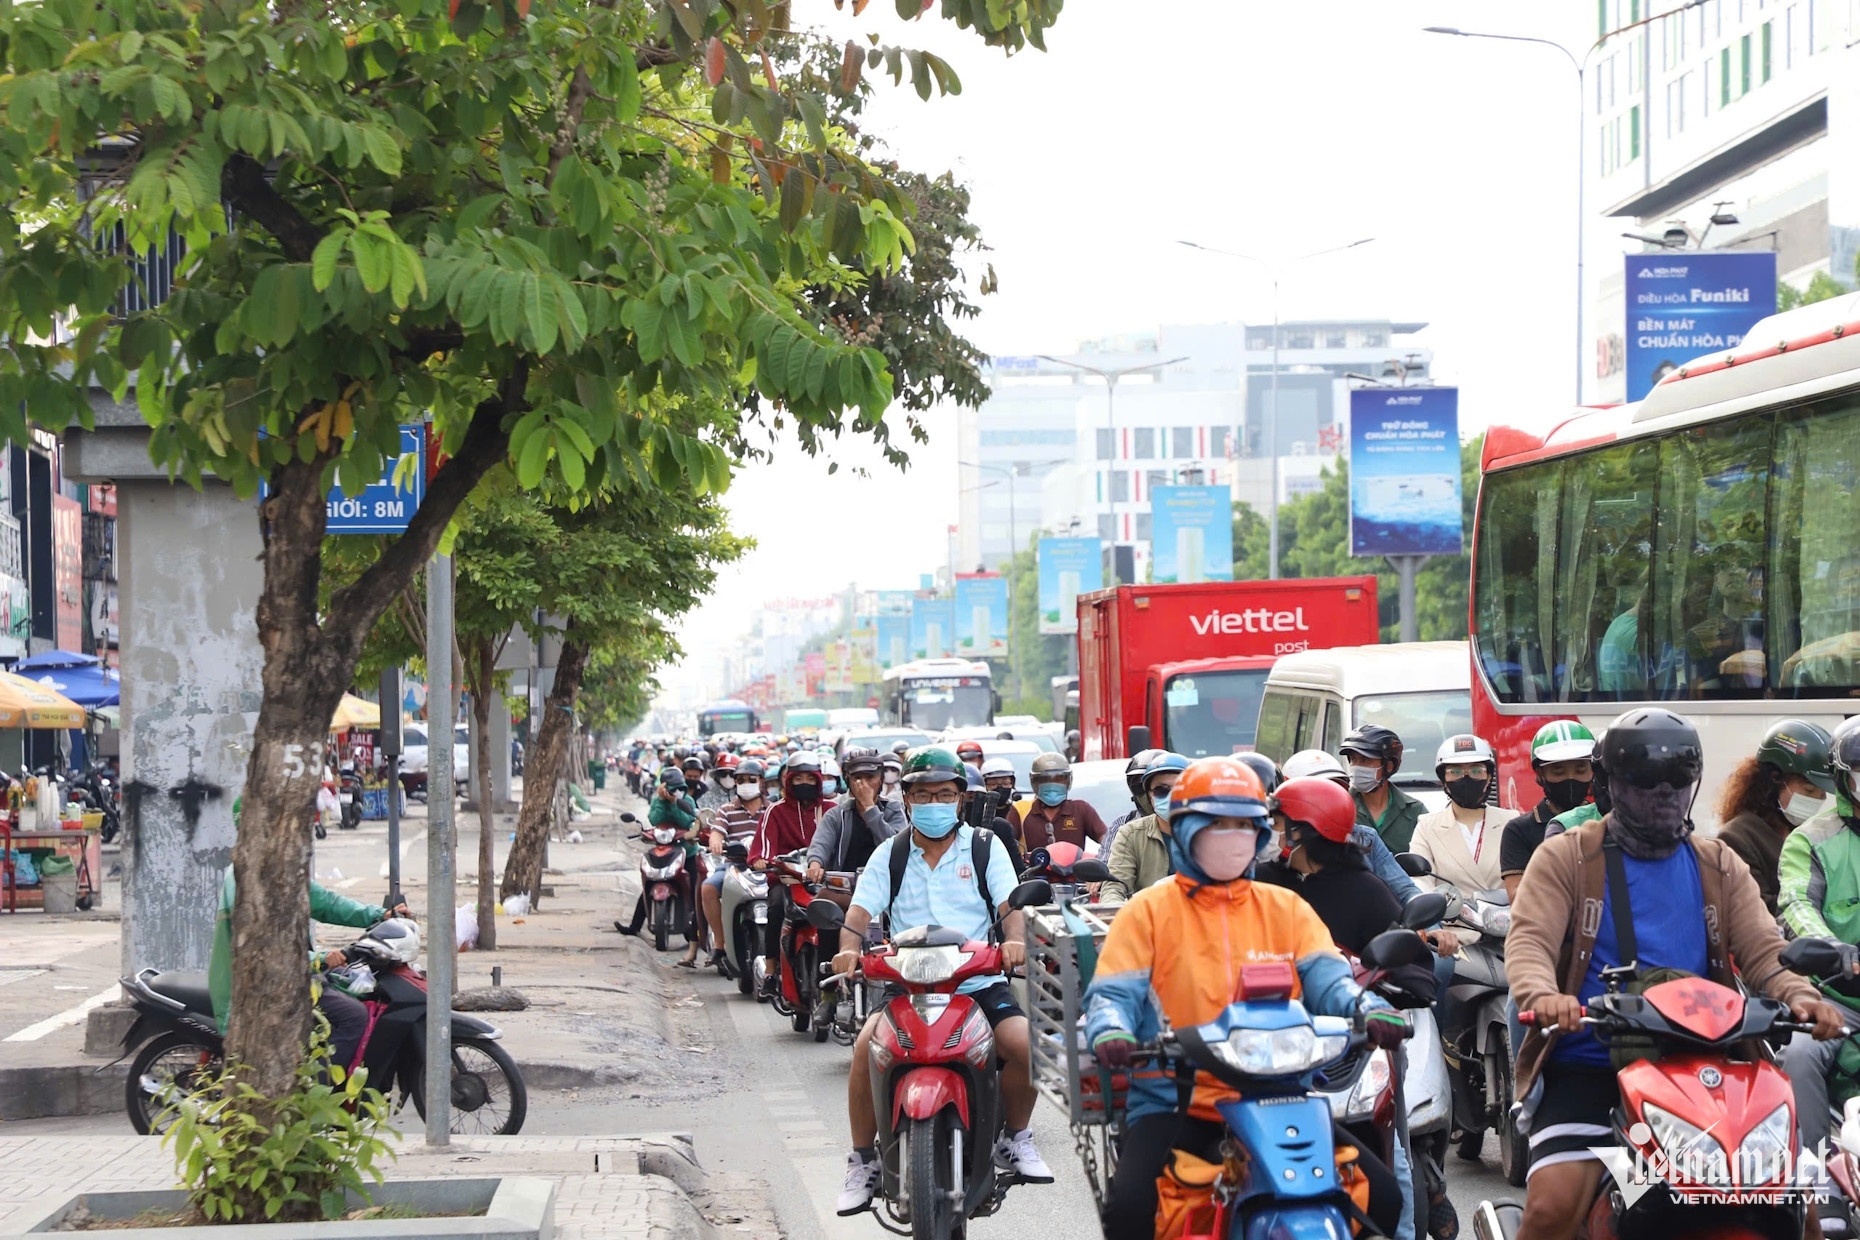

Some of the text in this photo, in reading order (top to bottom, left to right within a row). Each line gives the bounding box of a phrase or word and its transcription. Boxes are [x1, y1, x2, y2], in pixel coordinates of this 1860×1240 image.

[1664, 293, 1687, 303] HÒA
[1690, 288, 1749, 303] Funiki
[1638, 317, 1695, 331] BỀN MÁT
[1638, 332, 1746, 348] CHUẨN HÒA PH
[375, 501, 404, 518] 8M
[1189, 607, 1309, 635] viettel
[1274, 639, 1309, 655] post
[350, 733, 373, 745] SALE
[283, 741, 323, 779] 53
[1258, 1096, 1306, 1106] HONDA
